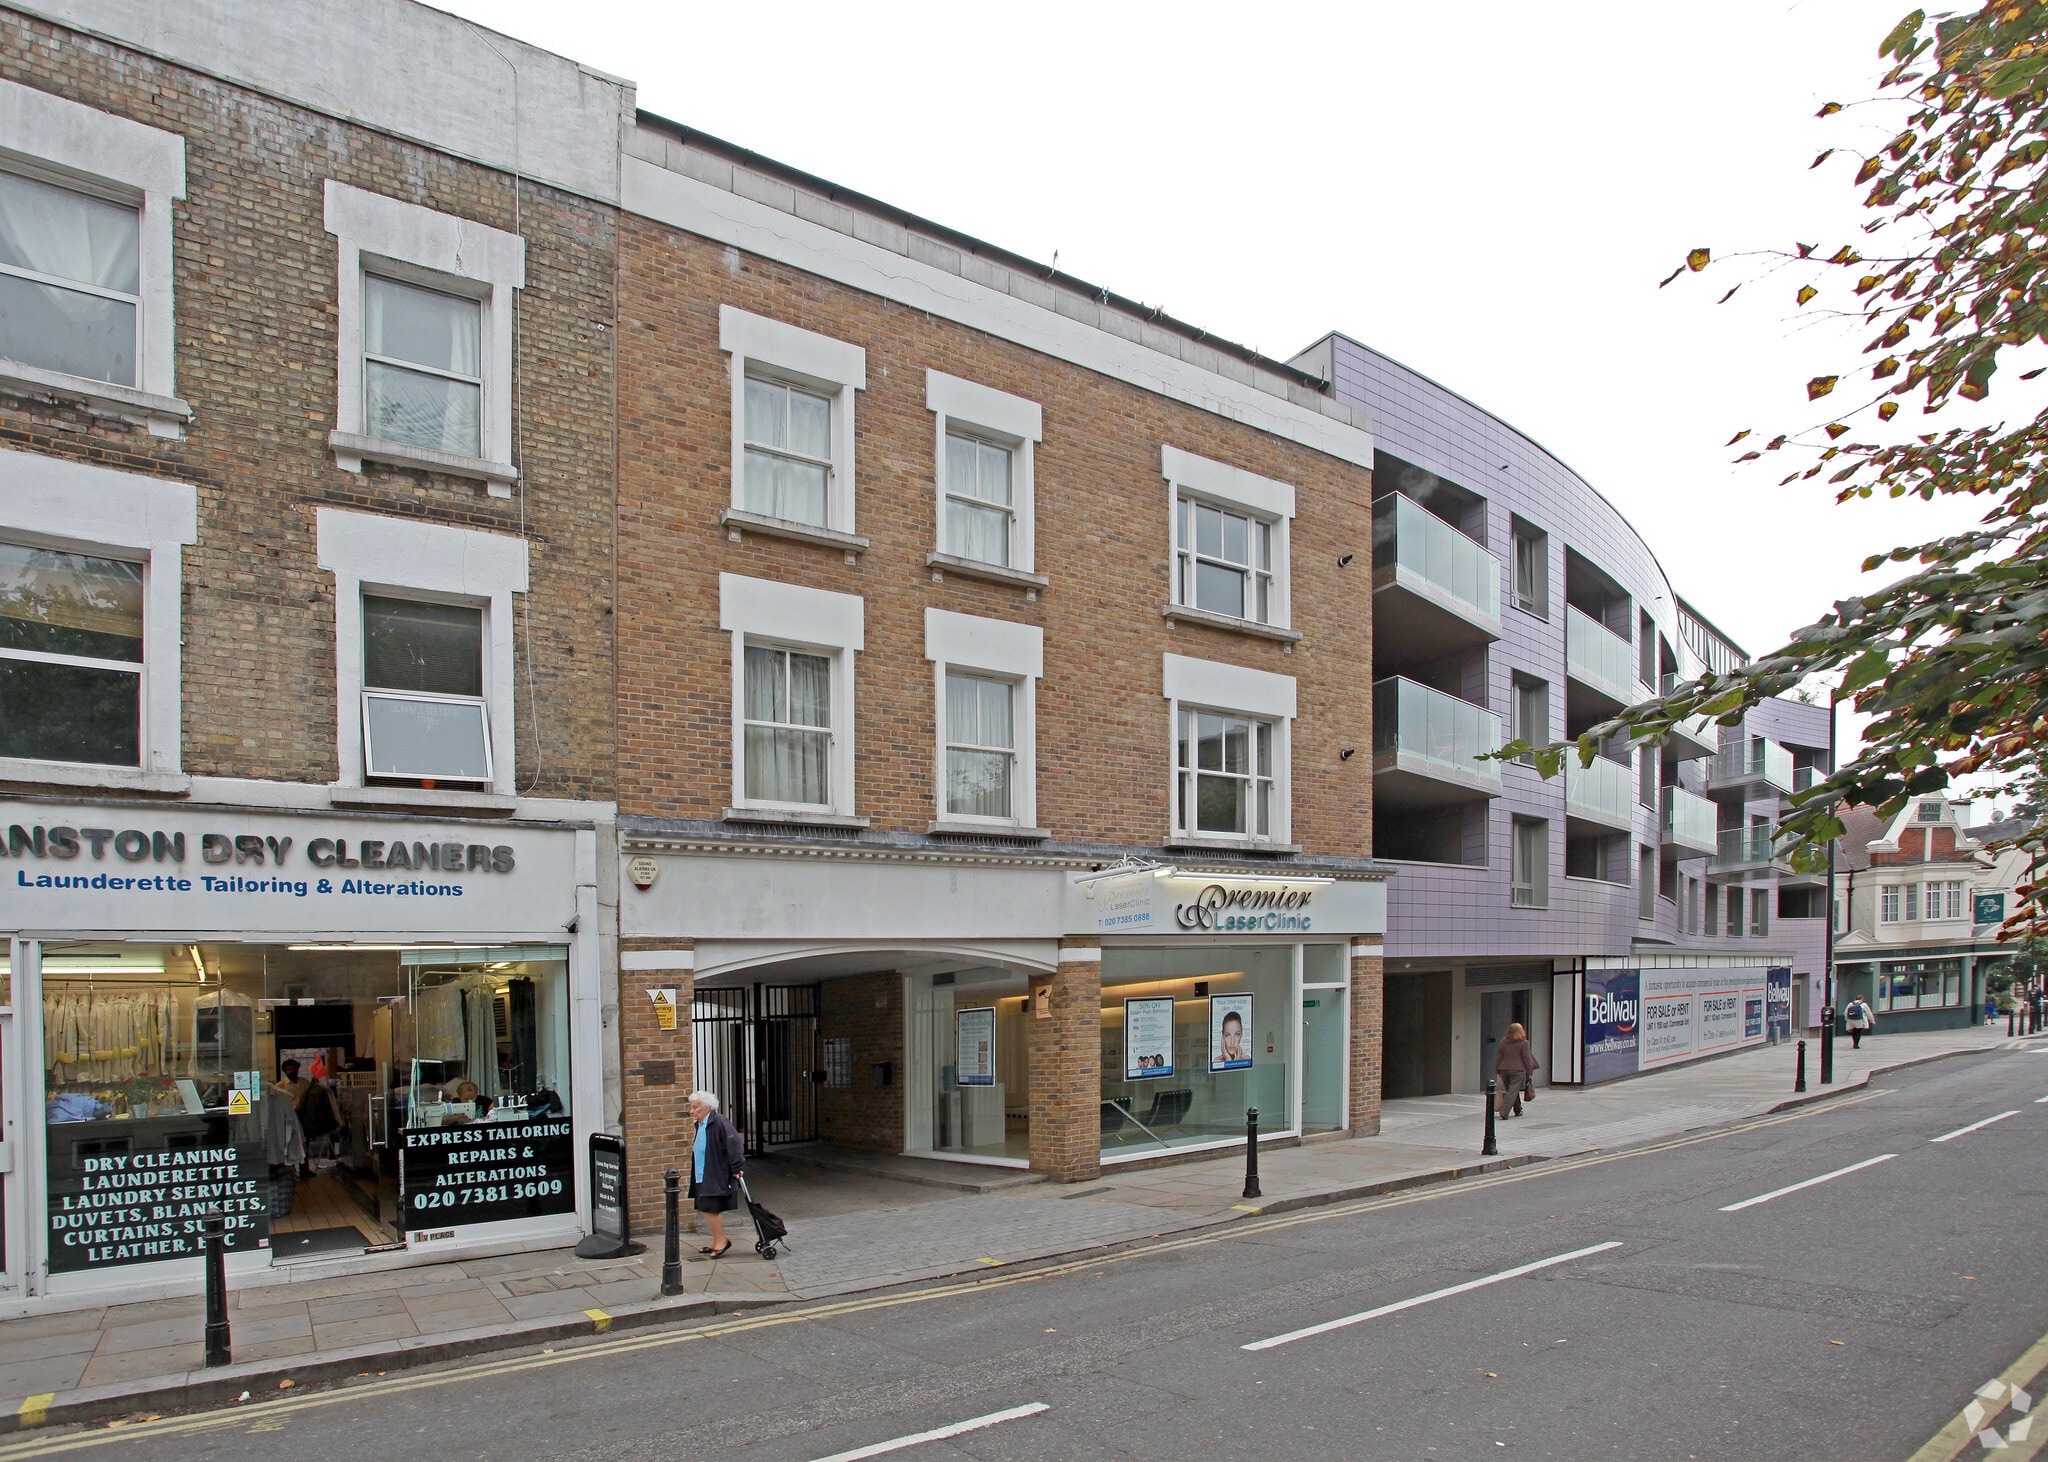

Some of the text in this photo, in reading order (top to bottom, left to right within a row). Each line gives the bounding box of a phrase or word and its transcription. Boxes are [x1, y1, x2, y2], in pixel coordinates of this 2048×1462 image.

[0, 824, 516, 873] NSTON DRY CLEANERS
[18, 870, 464, 897] Launderette Tailoring & Alterations
[1110, 898, 1151, 911] LaserClinic
[1174, 884, 1312, 930] Premier
[1104, 917, 1116, 926] 020
[1116, 915, 1133, 925] 7385
[1133, 912, 1150, 922] 0888
[1214, 912, 1312, 930] LaserClinic
[1704, 1000, 1712, 1012] FOR
[1713, 1000, 1722, 1011] SALE
[1727, 998, 1736, 1010] RENT
[1768, 982, 1789, 1006] Bellway
[1590, 992, 1637, 1028] Bellway
[1647, 1003, 1689, 1020] FOR SALE or RENT
[407, 1123, 571, 1148] EXPRESS TAILORING
[84, 1148, 237, 1173] DRY CLEANING
[448, 1146, 534, 1165] REPAIRS &
[82, 1165, 239, 1191] LAUNDERETTE
[435, 1165, 547, 1187] ALTERATIONS
[62, 1180, 257, 1211] LAUNDRY SERVICE
[414, 1179, 563, 1210] 020 7381 3609
[52, 1207, 148, 1230] DUVETS,
[63, 1214, 256, 1246] CURTAINS, SUDE,
[430, 1231, 456, 1240] PLACE
[87, 1239, 192, 1262] LEATHER,
